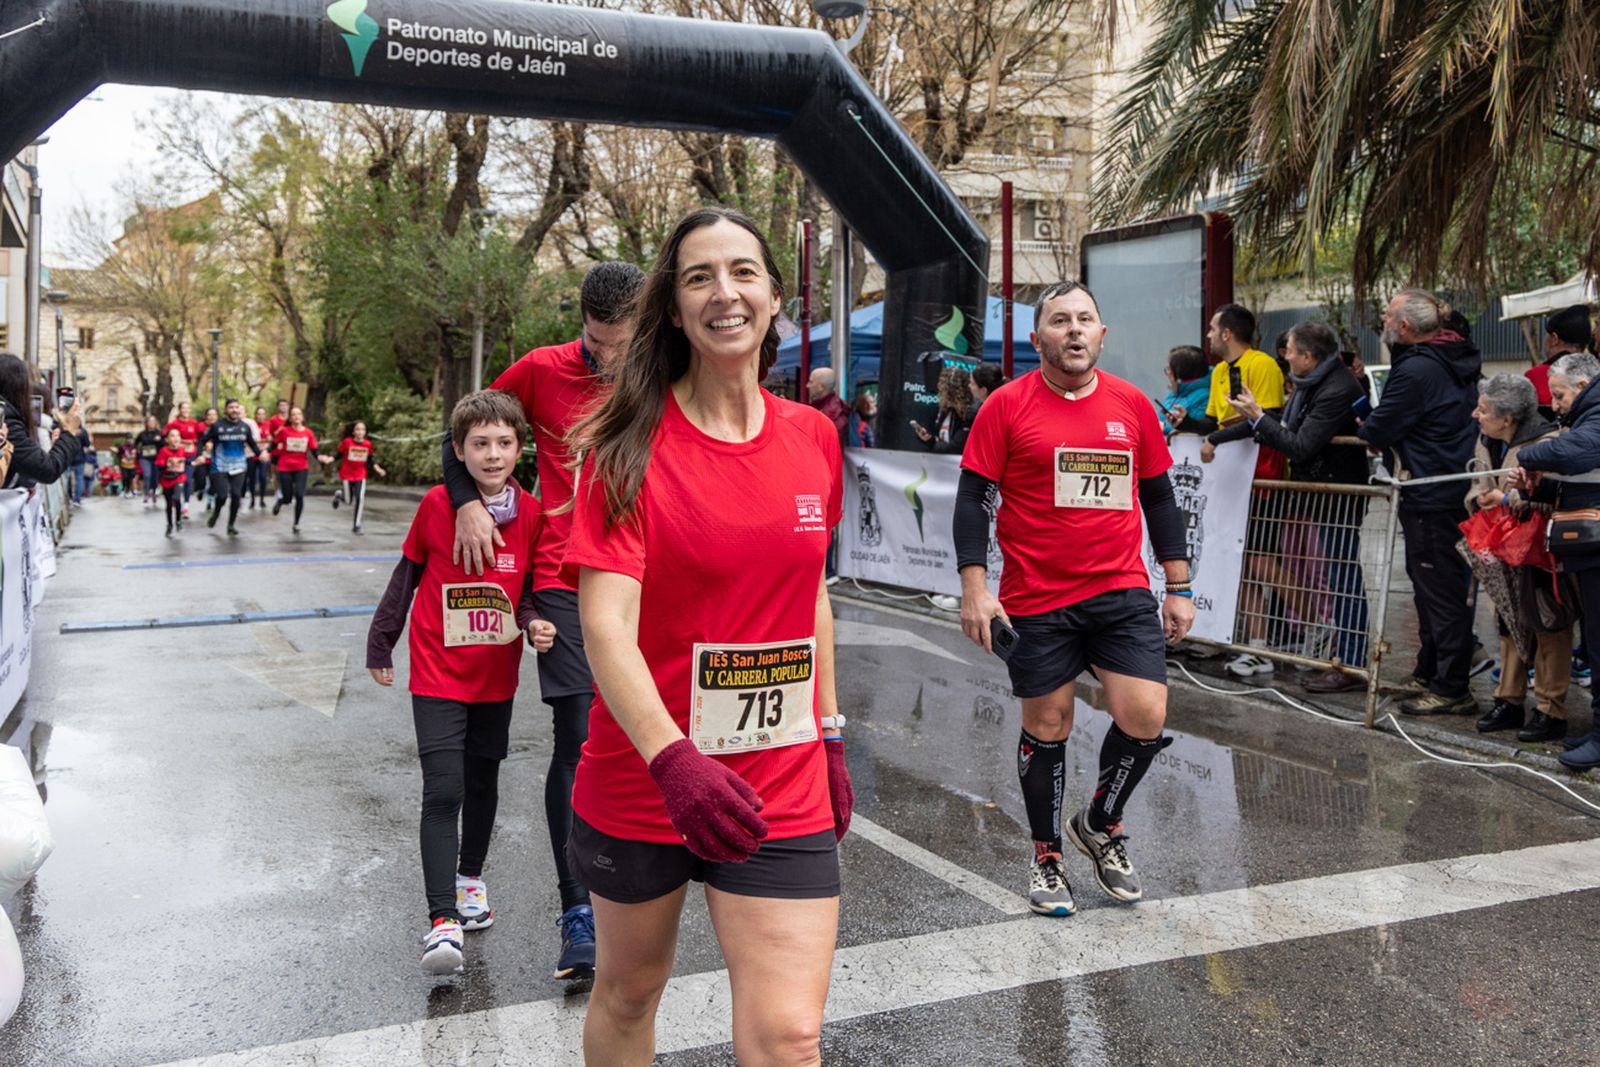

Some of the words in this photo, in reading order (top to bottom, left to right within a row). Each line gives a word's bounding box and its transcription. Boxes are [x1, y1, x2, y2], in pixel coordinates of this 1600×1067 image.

[386, 17, 488, 46] Patronato
[492, 28, 588, 57] Municipal
[593, 39, 619, 59] de
[386, 40, 482, 67] Deportes
[487, 50, 513, 71] de
[517, 53, 566, 76] Jaén
[903, 381, 926, 393] Patro
[914, 393, 940, 405] Depo
[1076, 453, 1090, 462] San
[1091, 454, 1107, 463] Juan
[1061, 462, 1067, 471] V
[1068, 462, 1100, 473] CARRERA
[1101, 463, 1128, 475] POPULAR
[1080, 475, 1111, 497] 712
[465, 589, 480, 597] San
[708, 653, 729, 668] IES
[732, 653, 755, 667] San
[757, 651, 780, 666] Juan
[782, 648, 809, 663] Bosco
[704, 671, 714, 686] V
[717, 669, 768, 686] CARRERA
[770, 663, 810, 683] POPULAR
[736, 688, 784, 732] 713
